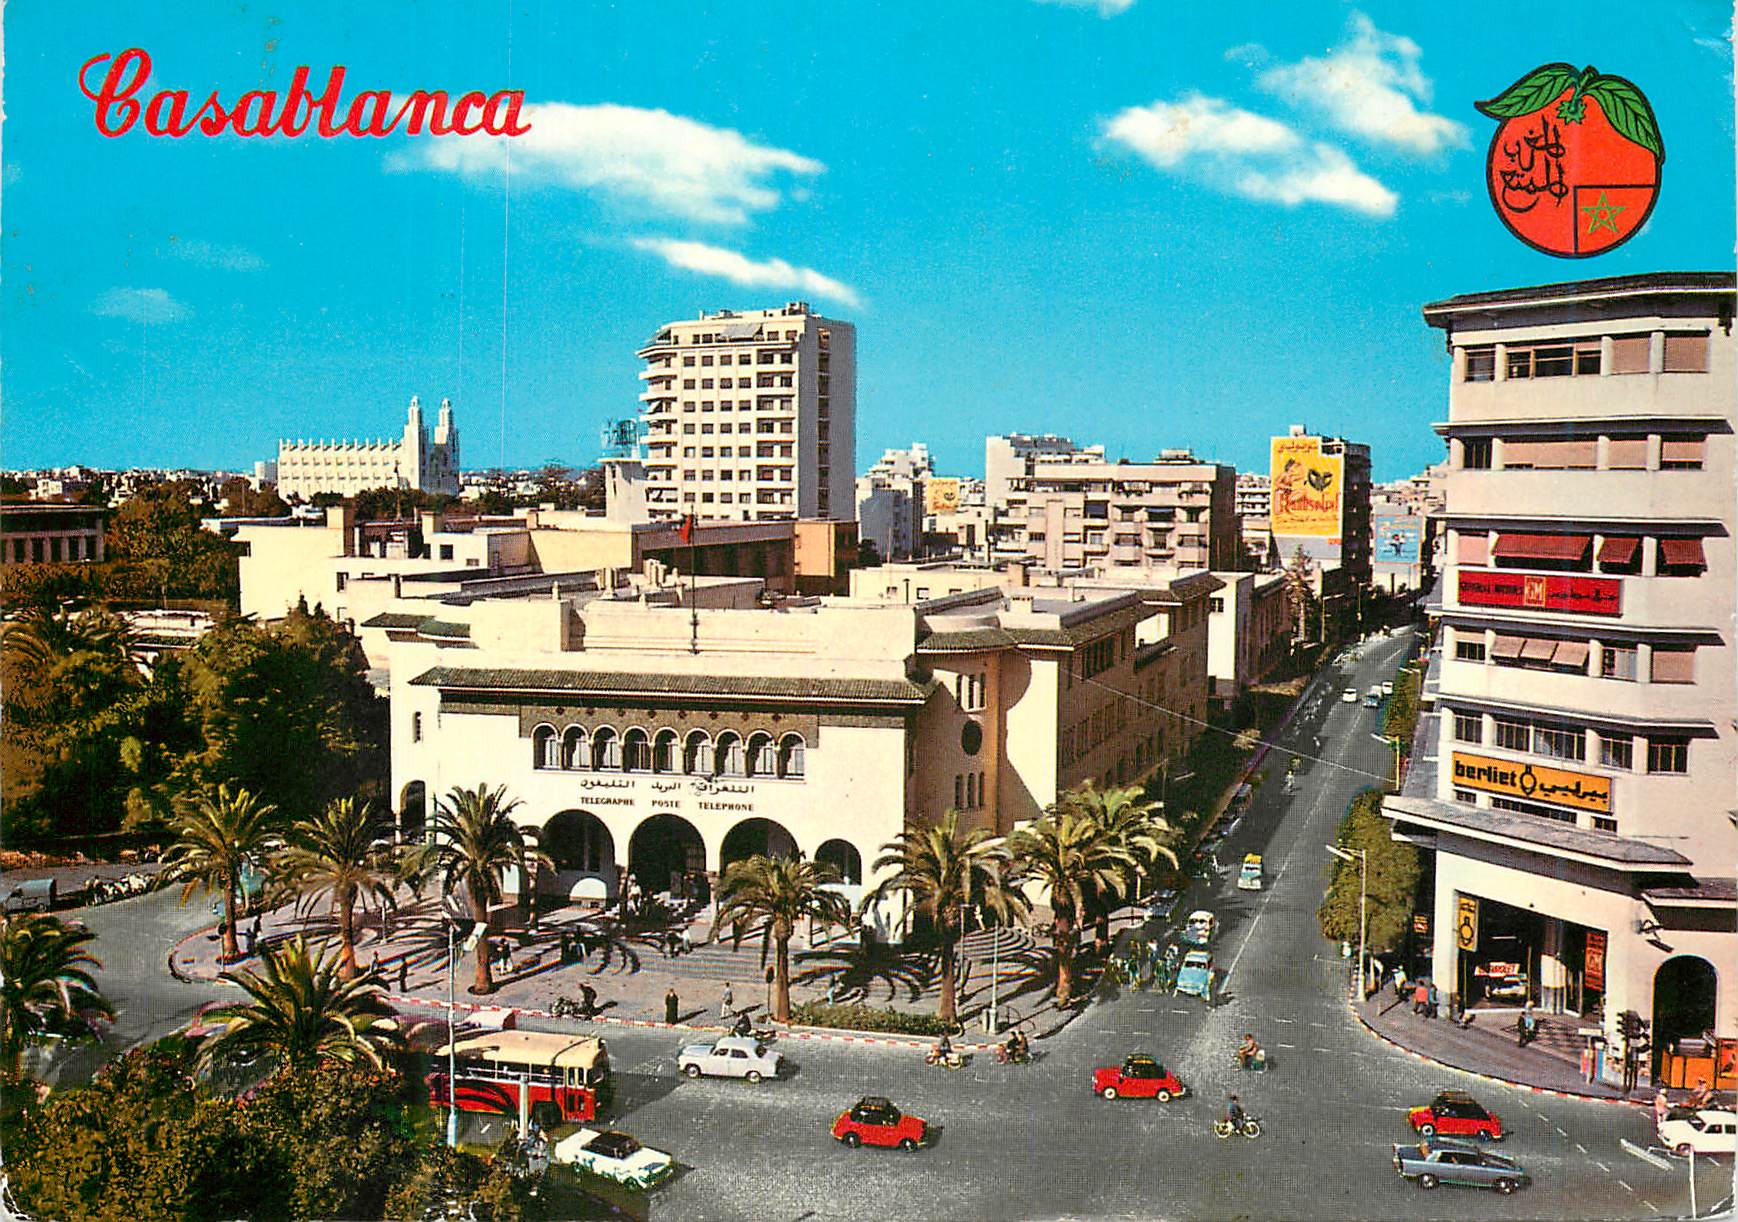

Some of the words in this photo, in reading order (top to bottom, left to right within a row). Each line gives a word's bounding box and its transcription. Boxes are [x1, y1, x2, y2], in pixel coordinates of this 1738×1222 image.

[1455, 760, 1517, 787] berliet
[651, 781, 681, 793] البريد
[580, 796, 635, 806] TELEGRAPHE
[651, 799, 680, 808] POSTE
[698, 801, 753, 812] TELEPHONE
